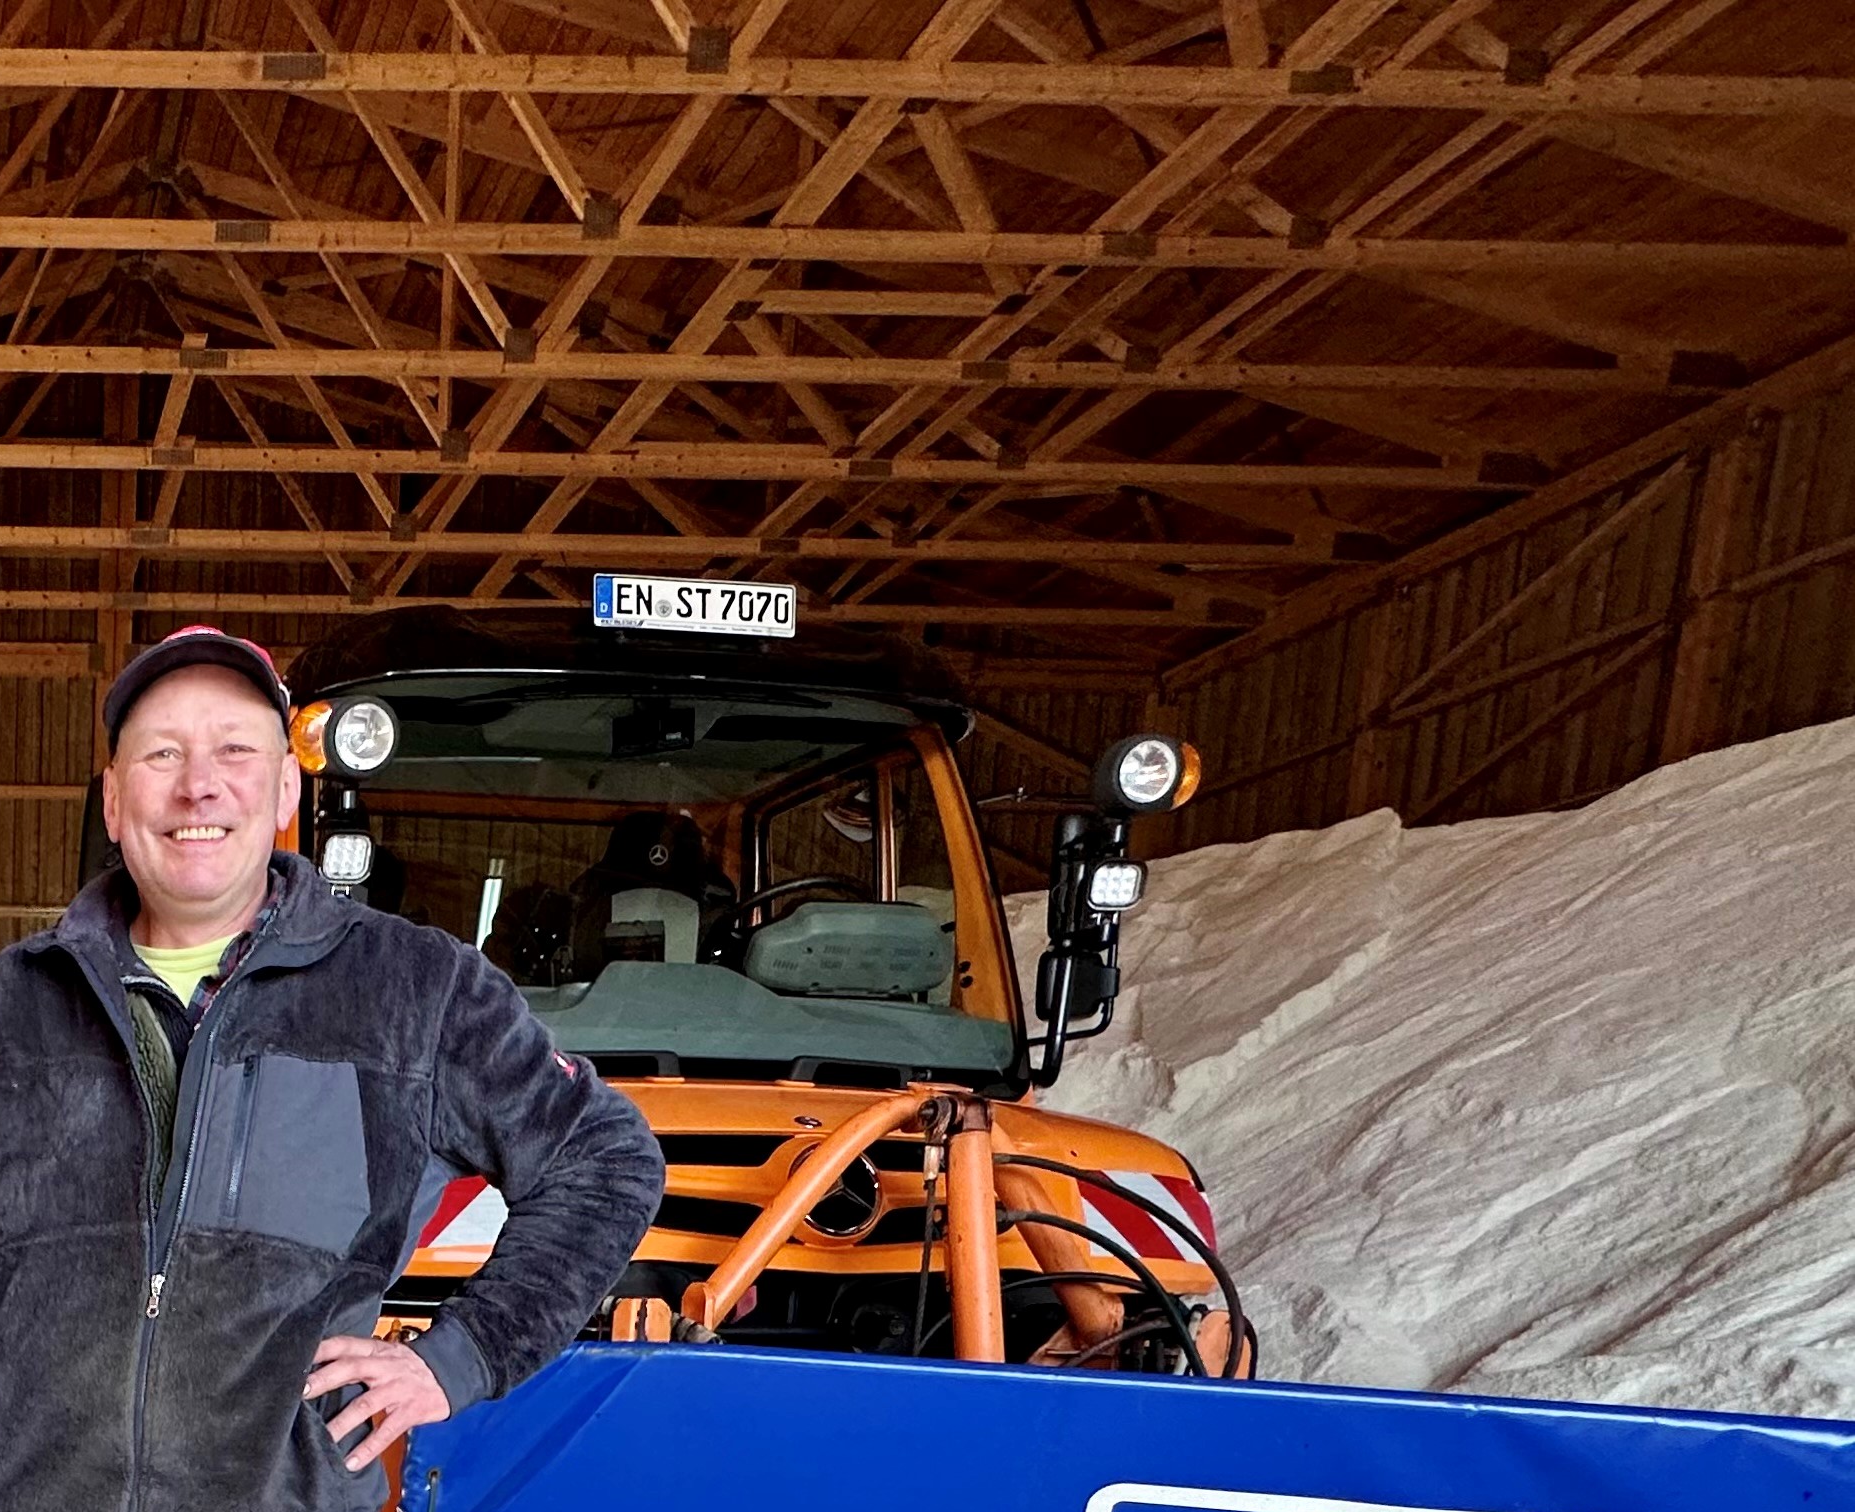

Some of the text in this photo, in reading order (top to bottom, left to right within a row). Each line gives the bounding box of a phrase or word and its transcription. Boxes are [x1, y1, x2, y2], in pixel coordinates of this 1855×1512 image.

[599, 583, 789, 624] D EN ST 7070
